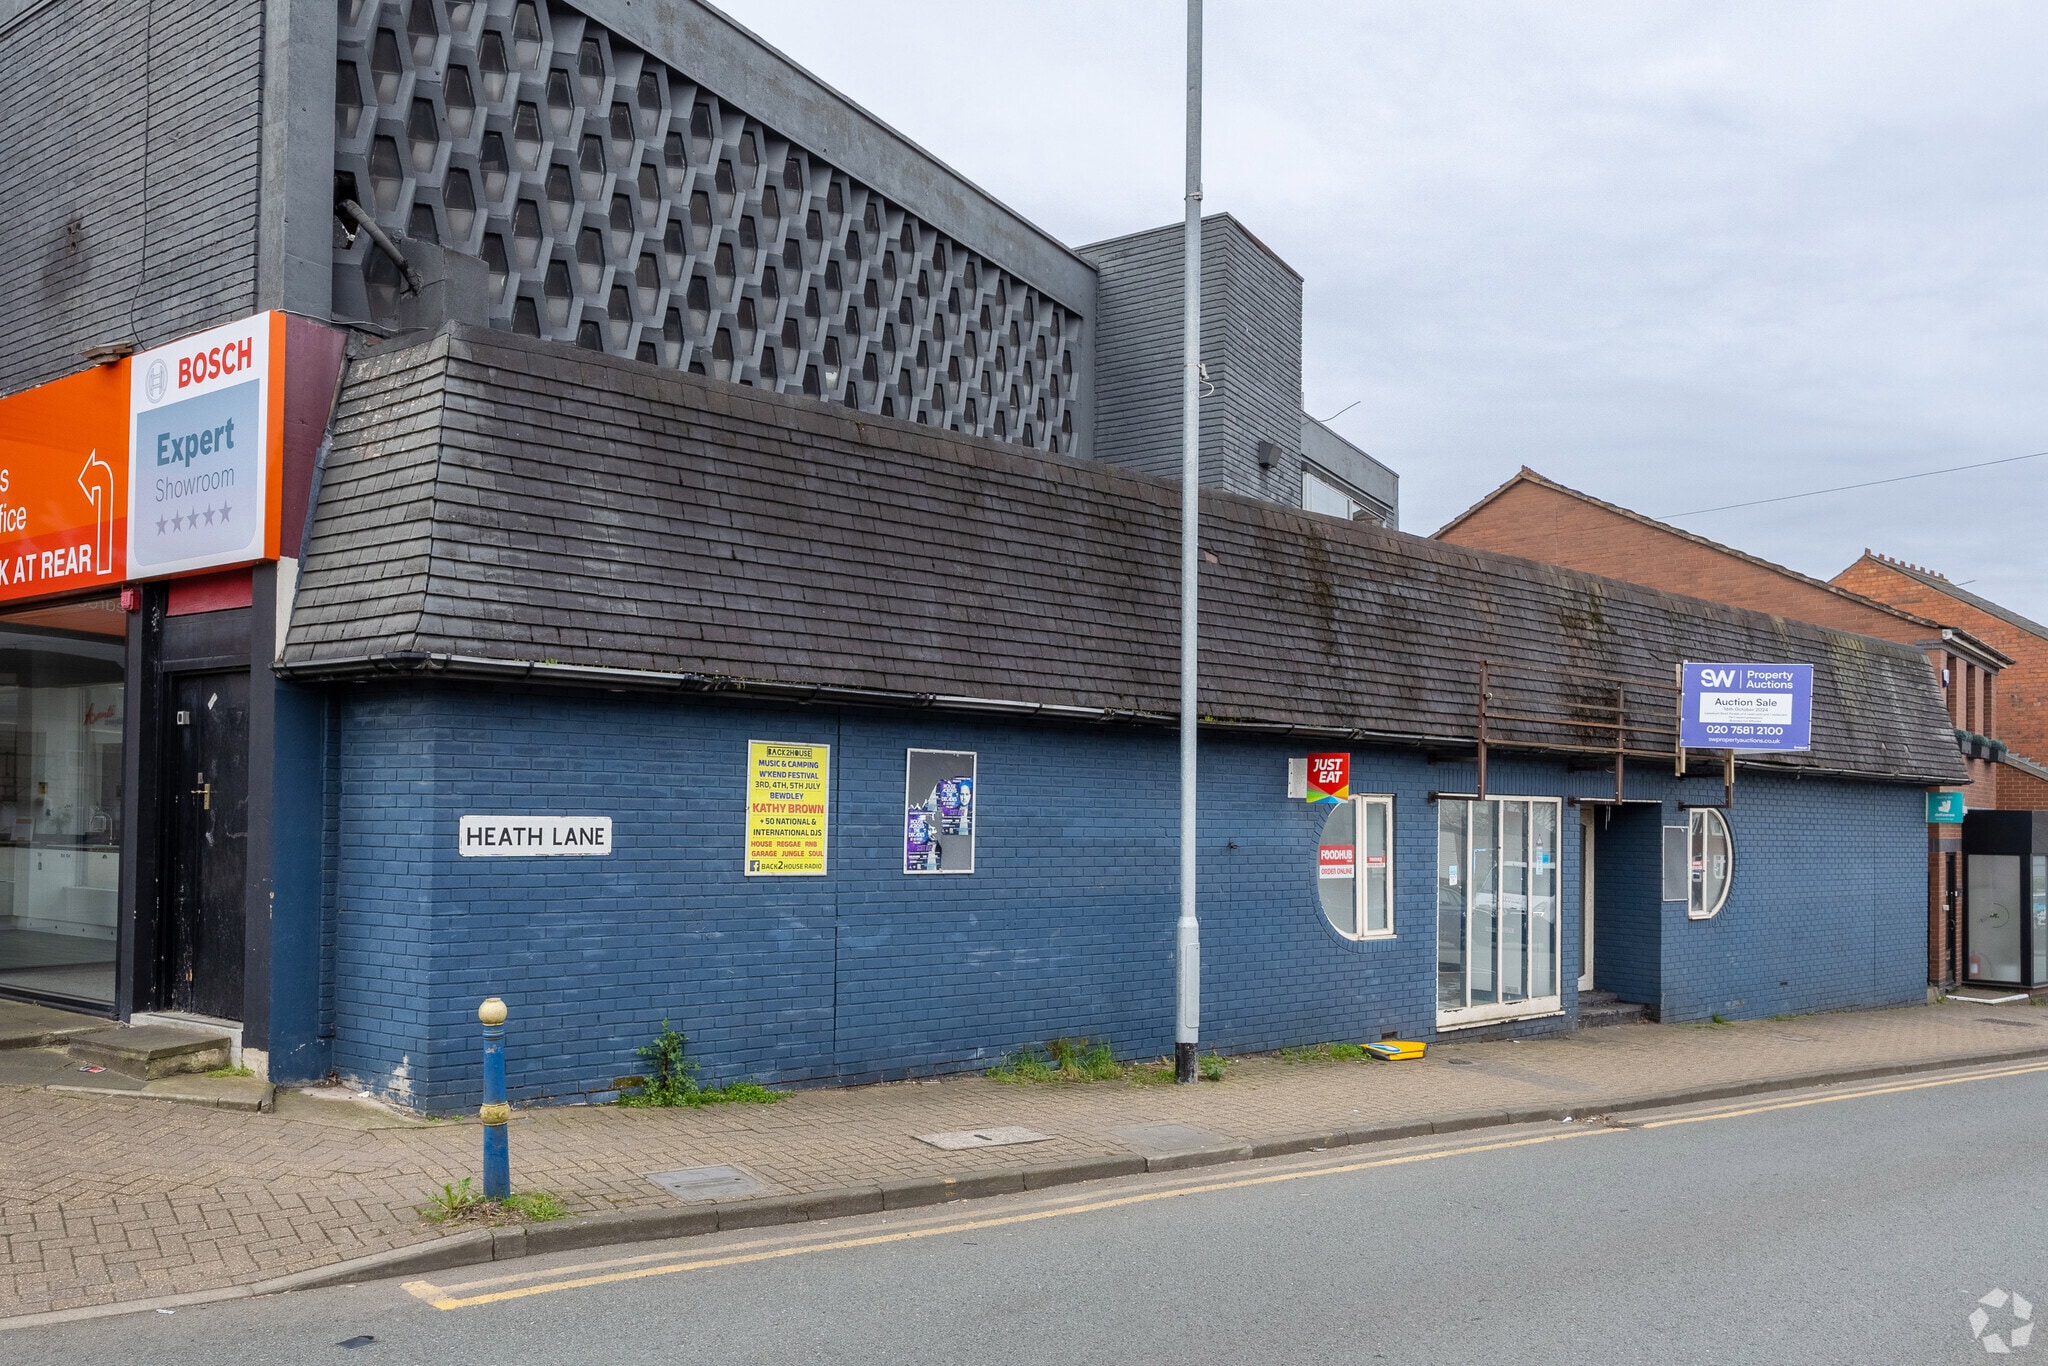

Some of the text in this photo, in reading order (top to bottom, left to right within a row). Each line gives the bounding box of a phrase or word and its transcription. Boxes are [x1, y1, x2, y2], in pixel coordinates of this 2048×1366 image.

[178, 337, 252, 388] BOSCH
[157, 417, 234, 467] Expert
[156, 468, 234, 502] Showroom
[13, 553, 37, 584] AT
[41, 544, 92, 579] REAR
[1700, 669, 1736, 688] SW
[1747, 670, 1794, 681] Property
[1745, 680, 1794, 689] Auctions
[1715, 697, 1778, 707] Auction Sale
[1706, 725, 1783, 736] 020 7581 2100
[758, 759, 780, 767] MUSIC
[1313, 758, 1343, 772] JUST
[759, 770, 819, 779] W'KEND FESTIVAL
[1319, 771, 1343, 783] EAT
[755, 781, 771, 789] 3RD,
[772, 781, 788, 789] 4TH,
[752, 803, 824, 814] KATHY BROWN
[467, 827, 605, 846] HEATH LANE
[1321, 849, 1353, 860] FOODHUB
[1337, 867, 1353, 875] ONLINE
